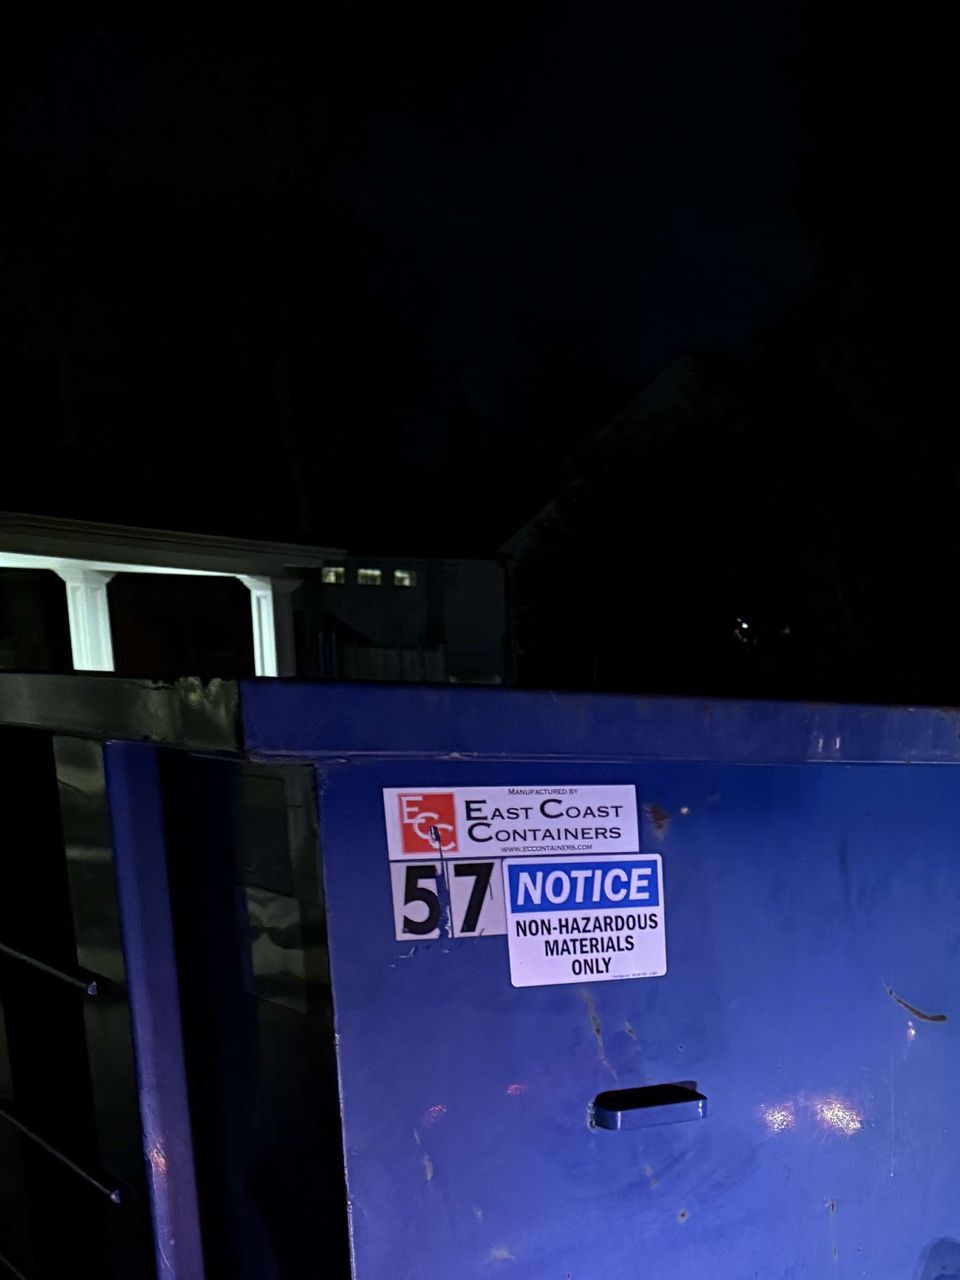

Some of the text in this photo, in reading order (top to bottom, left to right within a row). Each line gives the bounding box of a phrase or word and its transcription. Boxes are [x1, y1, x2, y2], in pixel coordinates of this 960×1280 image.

[464, 798, 623, 821] EAST COAST
[467, 822, 622, 843] CONTAINERS
[516, 867, 652, 906] NOTICE
[402, 862, 494, 935] 57
[515, 913, 658, 937] NON-HAZARDOUS
[544, 935, 635, 957] MATERIALS
[571, 957, 612, 976] ONLY
